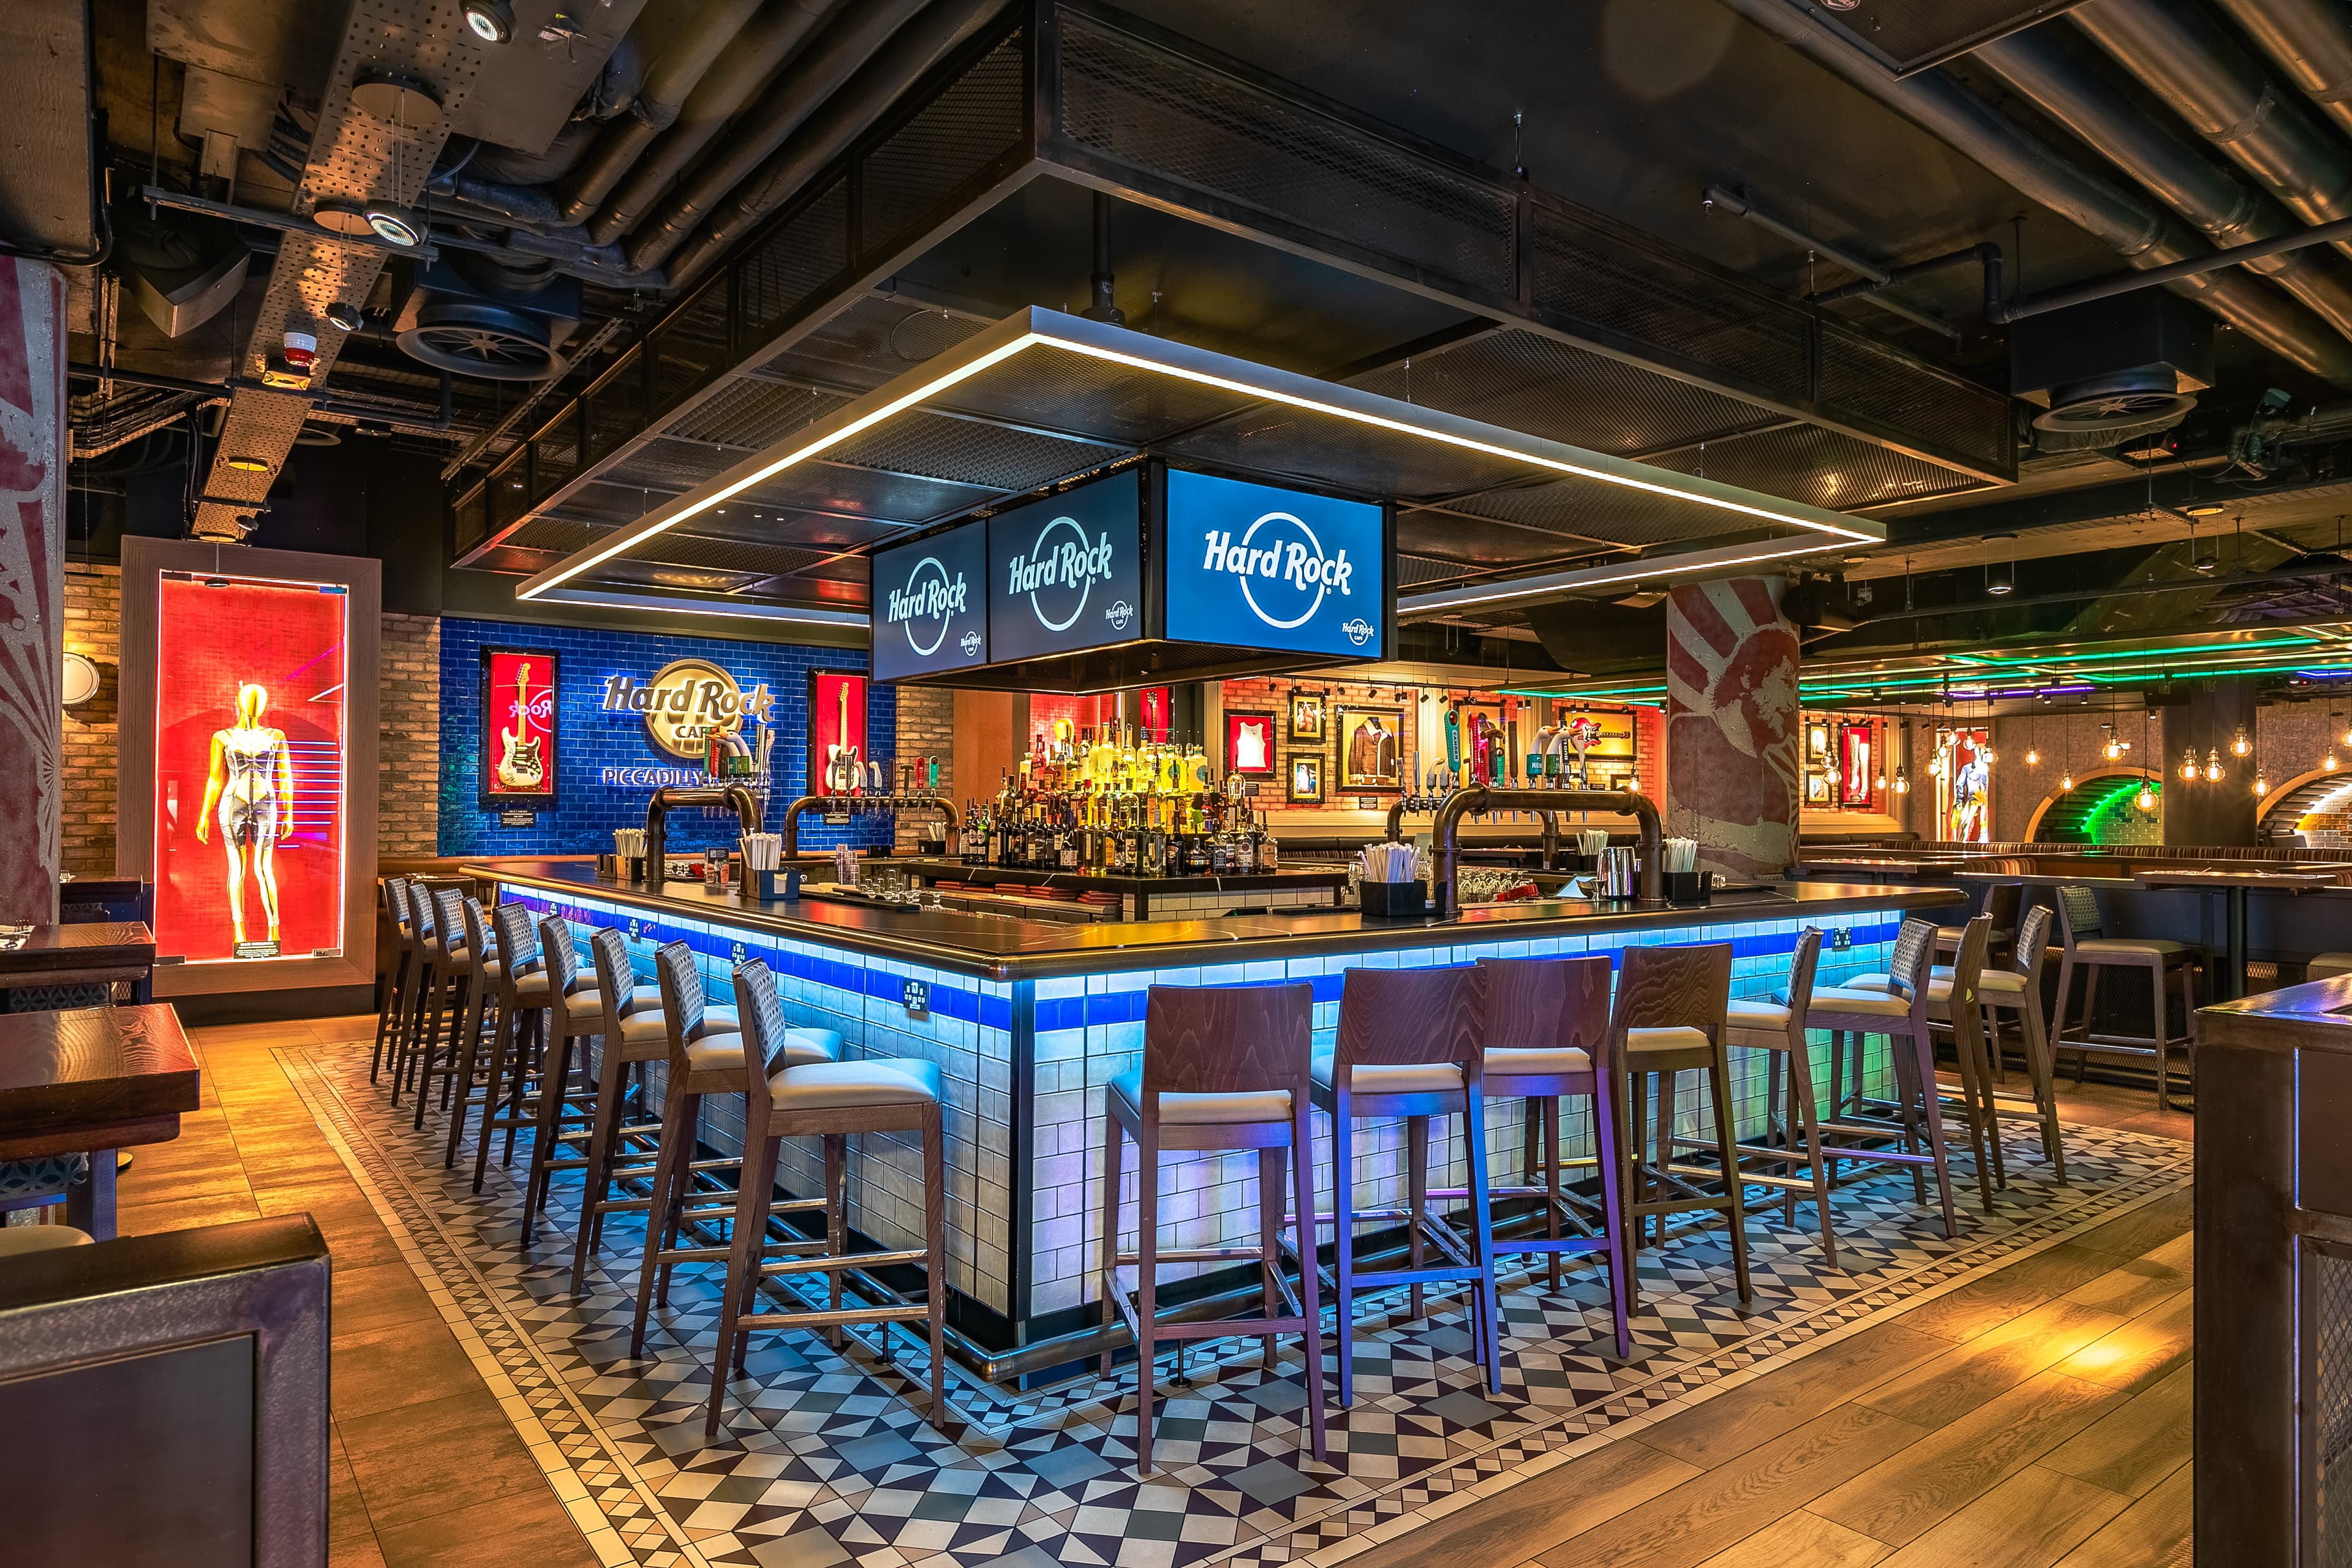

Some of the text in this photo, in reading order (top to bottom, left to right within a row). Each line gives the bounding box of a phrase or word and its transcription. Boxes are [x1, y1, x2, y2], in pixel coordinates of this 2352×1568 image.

[1009, 532, 1112, 595] Hard Rock
[1203, 530, 1352, 595] Hard Rock
[888, 571, 967, 623] Hard Rock
[1106, 605, 1133, 619] Hard Rock
[1342, 622, 1374, 637] Hard Rock
[960, 635, 981, 647] Hard Rock
[604, 676, 775, 722] Hard Rock
[675, 726, 712, 739] CAF
[603, 769, 705, 785] PICCADILLY
